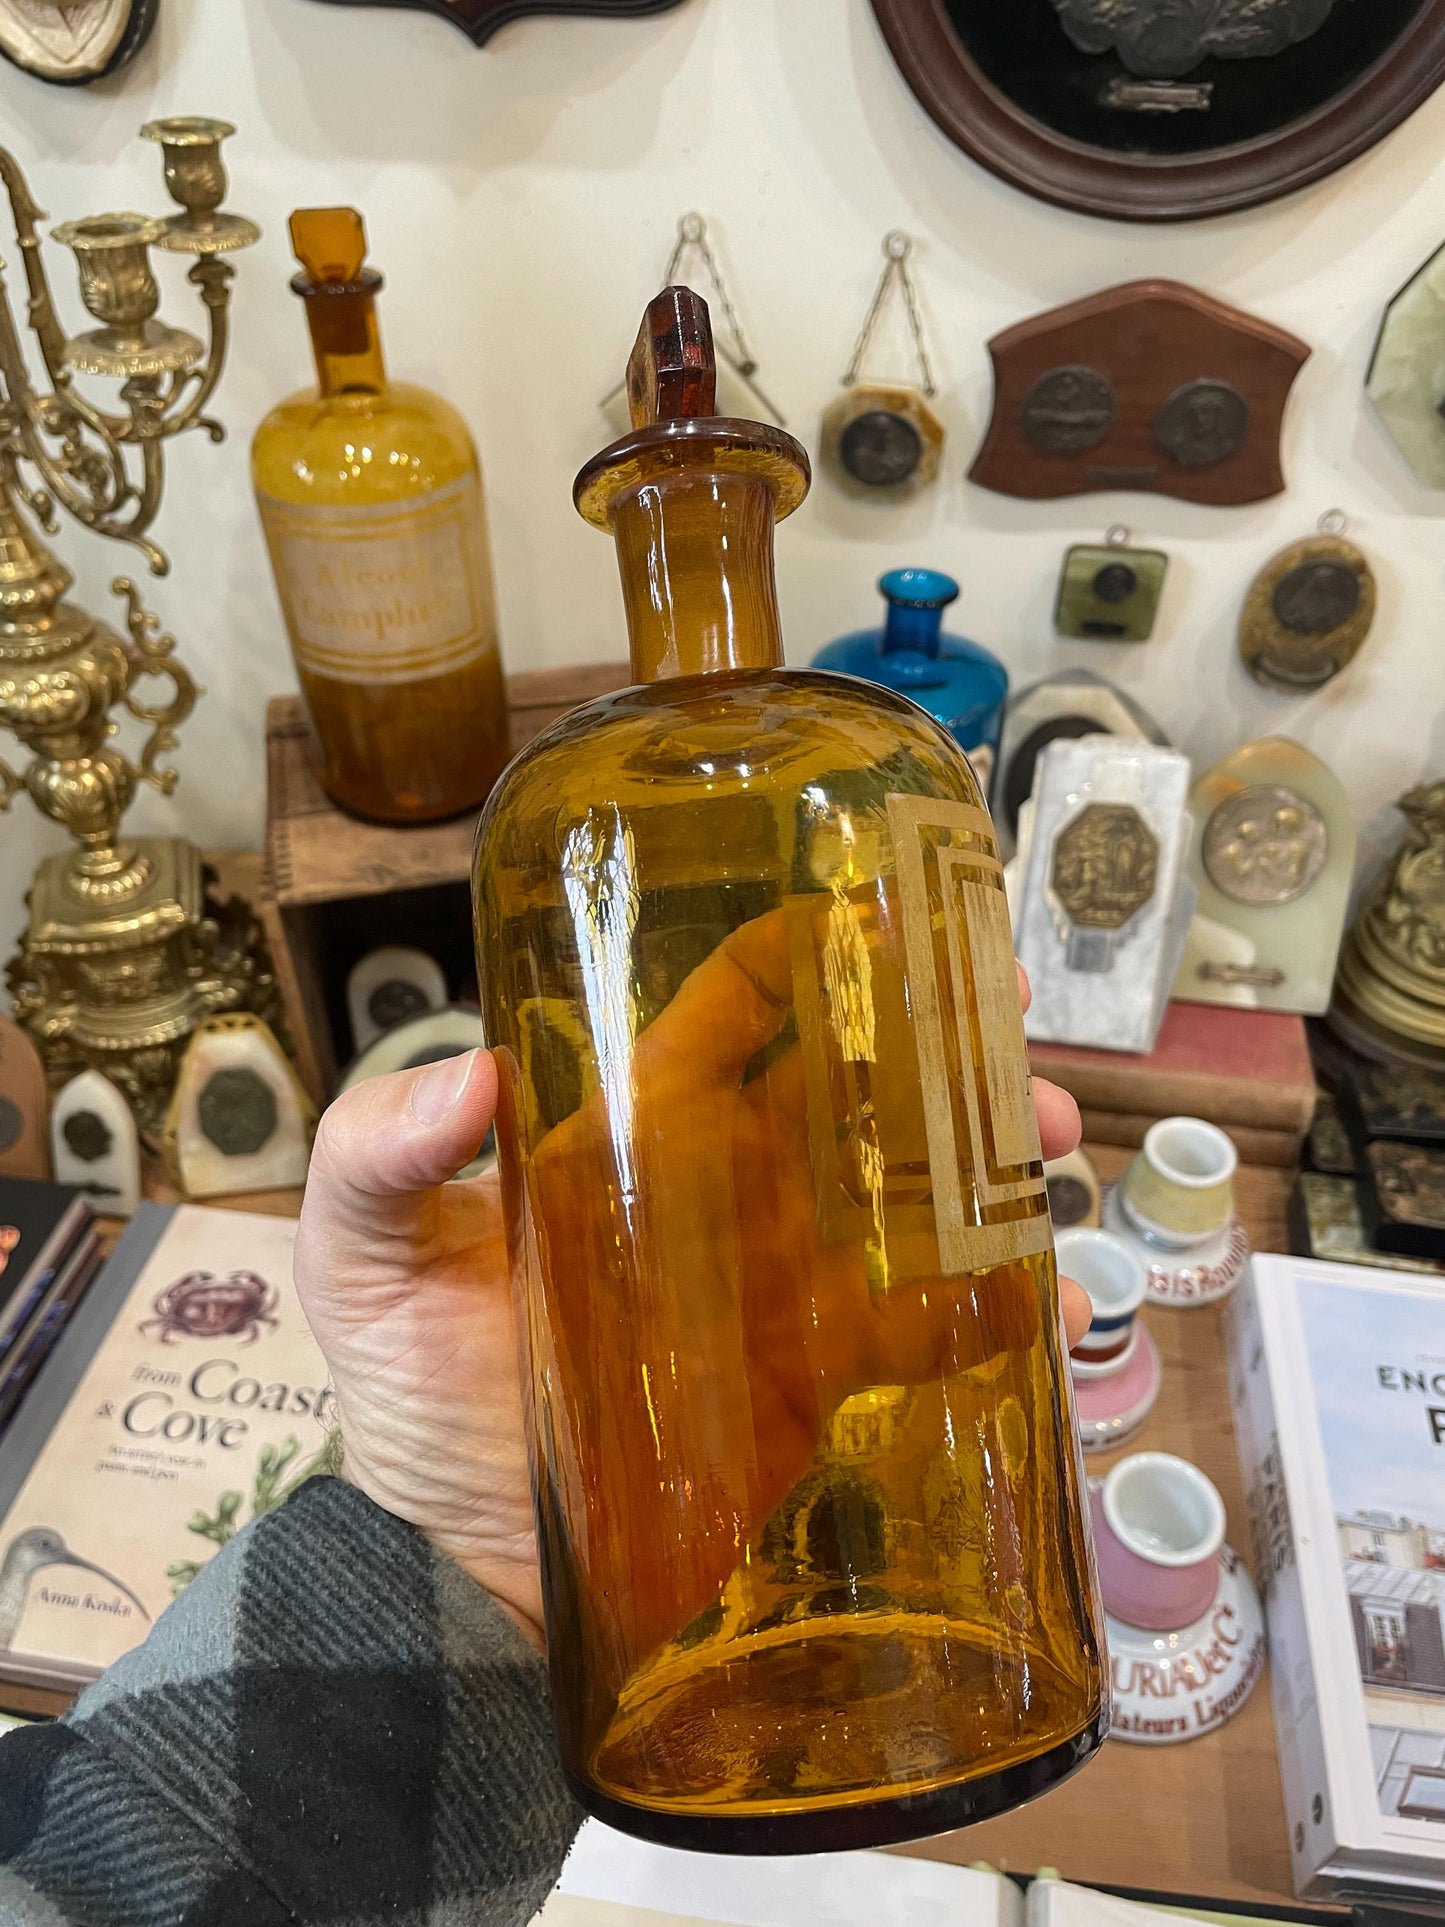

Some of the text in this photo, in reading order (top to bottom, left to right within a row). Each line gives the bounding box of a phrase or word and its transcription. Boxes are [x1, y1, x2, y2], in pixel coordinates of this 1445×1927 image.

[188, 1358, 334, 1418] Coast
[122, 1391, 248, 1450] Cove
[1112, 1703, 1187, 1734] lateurs
